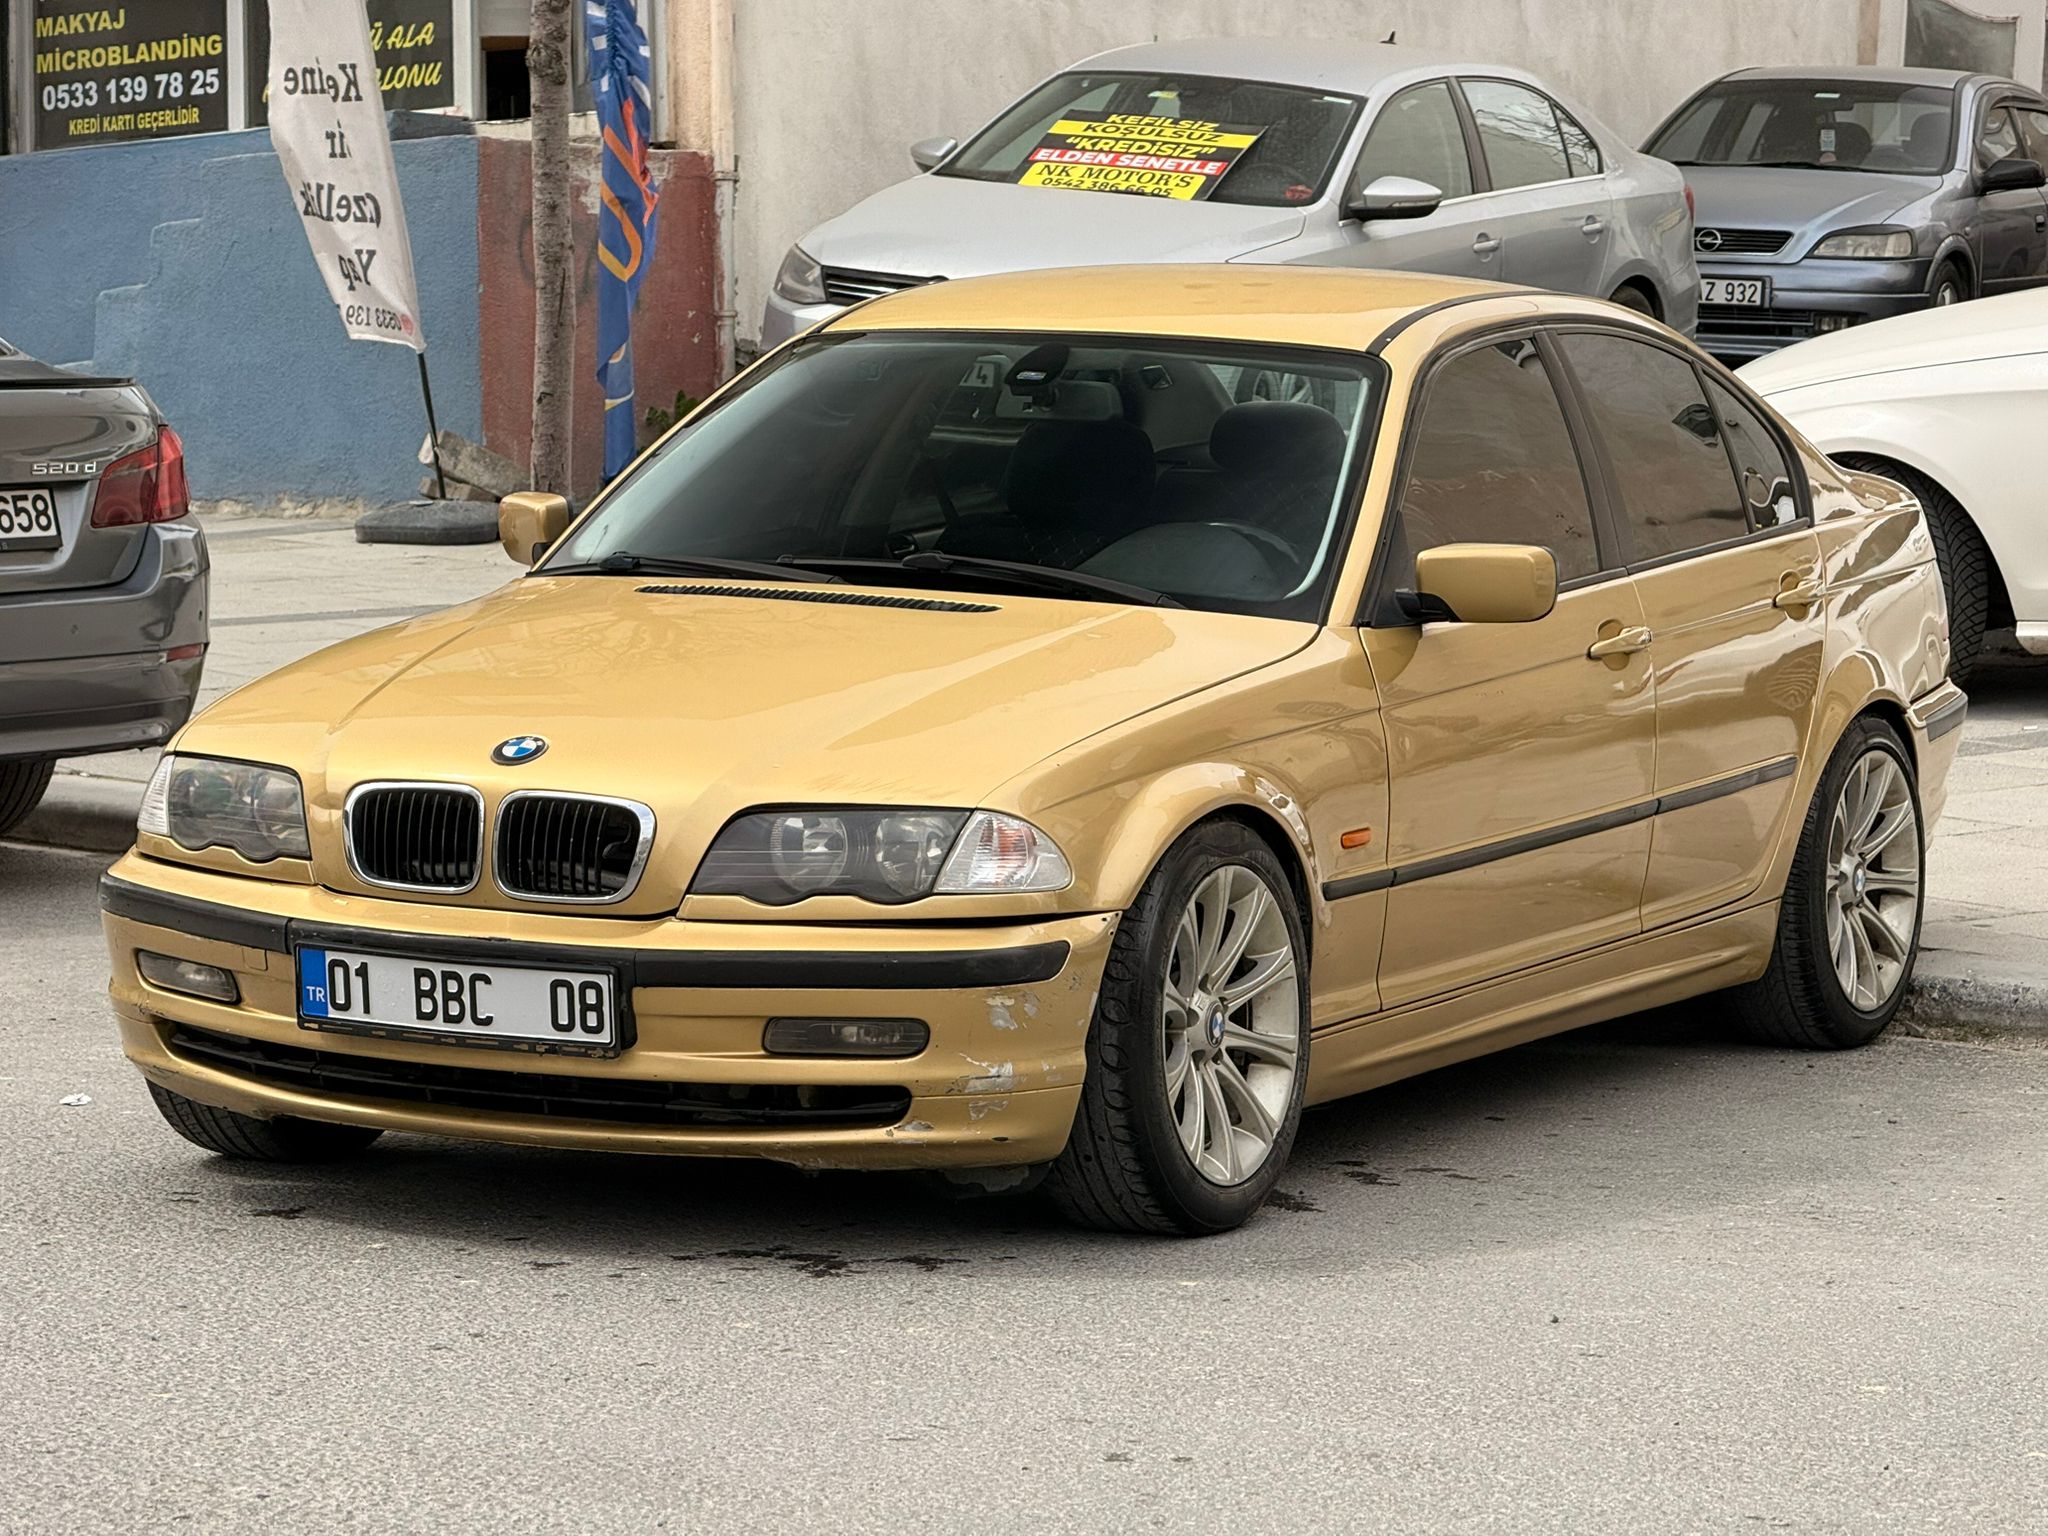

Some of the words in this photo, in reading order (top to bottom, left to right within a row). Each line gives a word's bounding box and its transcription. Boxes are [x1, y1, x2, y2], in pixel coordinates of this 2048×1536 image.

[36, 9, 125, 37] MAKYAJ
[387, 21, 434, 50] ALA
[36, 33, 223, 74] MİCROBLANDİNG
[42, 80, 98, 111] 0533
[106, 76, 147, 104] 139
[154, 72, 184, 99] 78
[190, 68, 219, 96] 25
[69, 113, 101, 136] KREDİ
[103, 112, 135, 132] KARTI
[137, 104, 200, 132] GEÇERLİDİR
[1083, 123, 1223, 143] KOŞULSUZ
[1036, 148, 1113, 165] ELDEN
[1115, 153, 1221, 174] SENETLE
[1037, 164, 1077, 178] NK
[1080, 166, 1195, 189] MOTOR'S
[1041, 177, 1082, 188] 0542
[1088, 180, 1120, 191] 386
[1151, 187, 1174, 197] 05
[1725, 282, 1758, 303] 932
[0, 493, 52, 534] 658
[306, 986, 326, 1003] TR
[327, 958, 371, 1015] 01
[413, 967, 494, 1027] BBC
[549, 978, 605, 1035] 08
